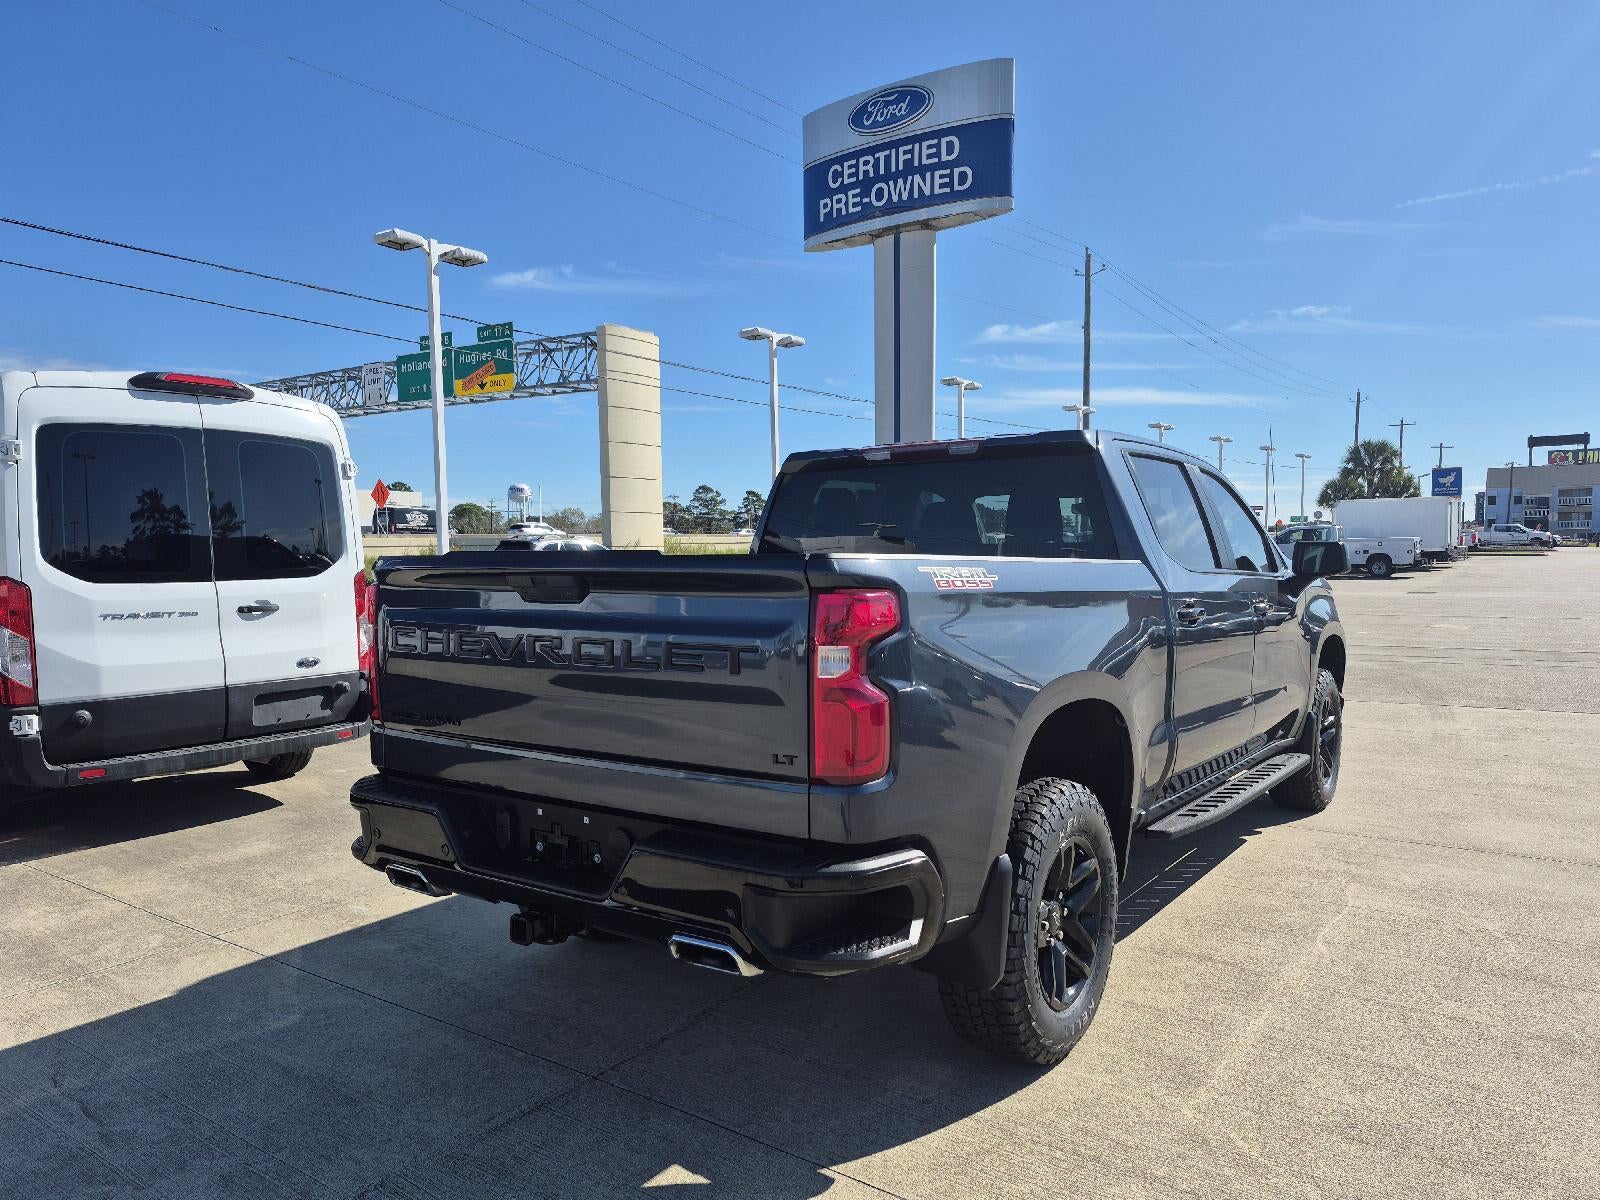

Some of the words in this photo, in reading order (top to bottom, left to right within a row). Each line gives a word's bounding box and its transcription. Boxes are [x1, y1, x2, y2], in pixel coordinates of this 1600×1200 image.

[863, 93, 911, 126] Ford
[827, 135, 960, 189] CERTIFIED
[818, 166, 973, 222] PRE-OWNED
[480, 330, 491, 338] EXIT
[495, 327, 502, 336] 17
[505, 326, 510, 335] A
[444, 336, 449, 344] B
[459, 351, 492, 364] Hughes
[496, 348, 508, 358] Rd
[367, 377, 381, 385] LIMIT
[489, 379, 507, 388] ONLY
[918, 566, 999, 580] TRAIL
[934, 579, 994, 590] BOSS
[98, 611, 176, 621] TRANSIT
[390, 625, 761, 676] CHEVROLET
[771, 753, 798, 766] LT
